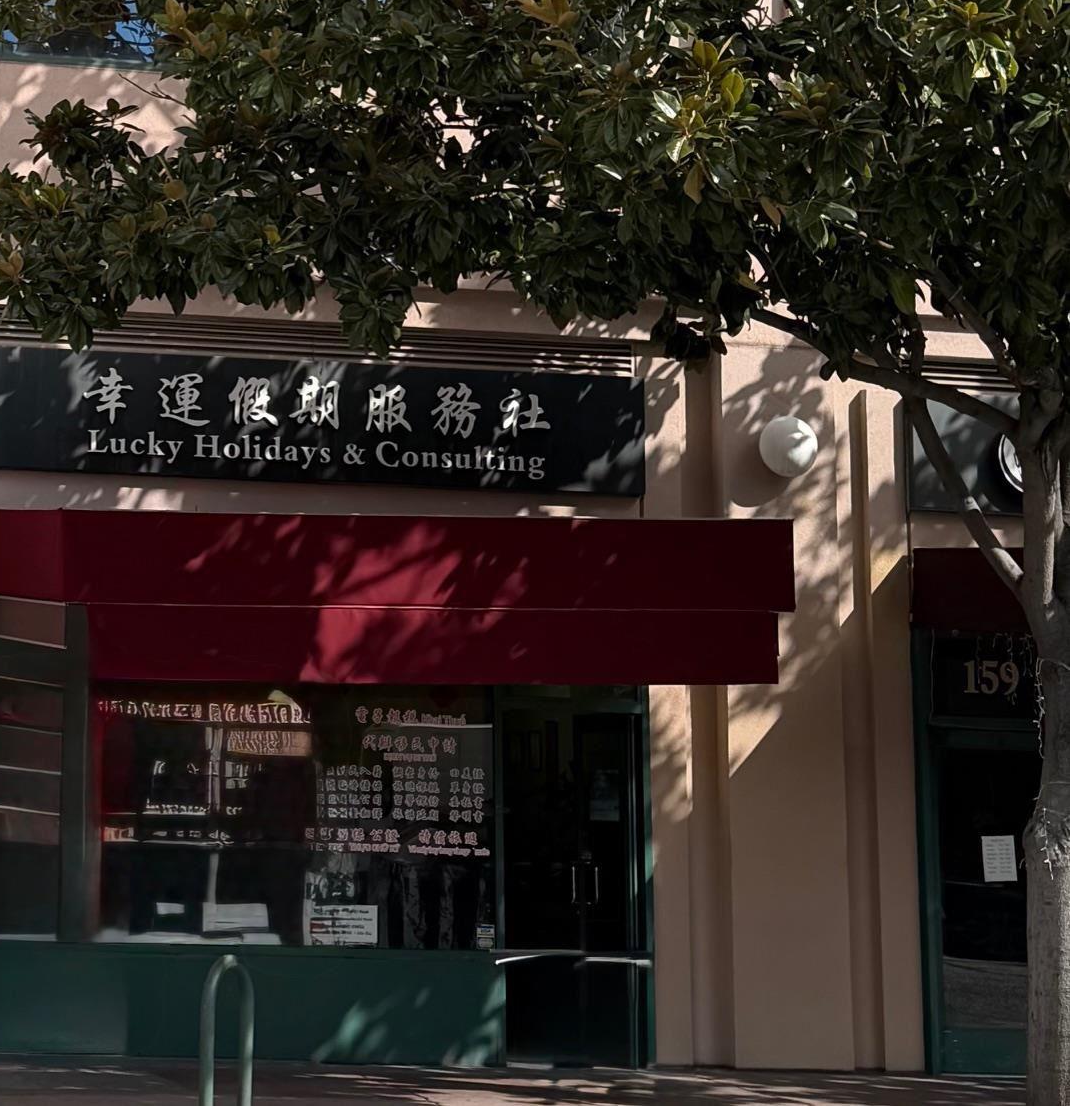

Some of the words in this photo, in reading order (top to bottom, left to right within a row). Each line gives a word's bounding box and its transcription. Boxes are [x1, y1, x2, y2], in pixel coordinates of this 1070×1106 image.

[84, 367, 551, 439] 幸運假期服務社
[87, 429, 184, 464] Lucky
[193, 434, 331, 470] Holidays
[343, 443, 366, 465] &
[375, 440, 546, 480] Consulting
[963, 660, 1019, 695] 159
